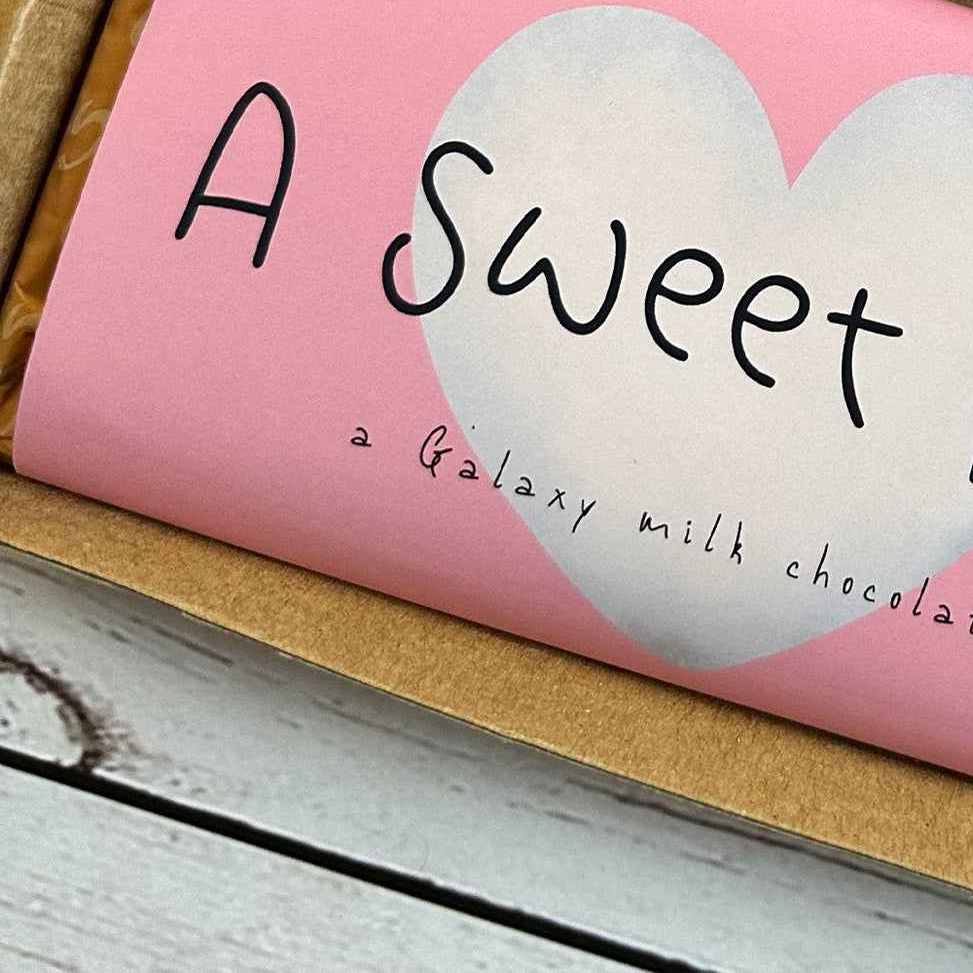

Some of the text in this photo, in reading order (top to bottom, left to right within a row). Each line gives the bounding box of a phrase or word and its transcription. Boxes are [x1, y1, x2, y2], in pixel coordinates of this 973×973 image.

[175, 82, 295, 268] A
[382, 141, 903, 428] Sweet
[351, 427, 371, 447] a
[420, 425, 596, 532] Galaxy
[640, 512, 742, 564] milk
